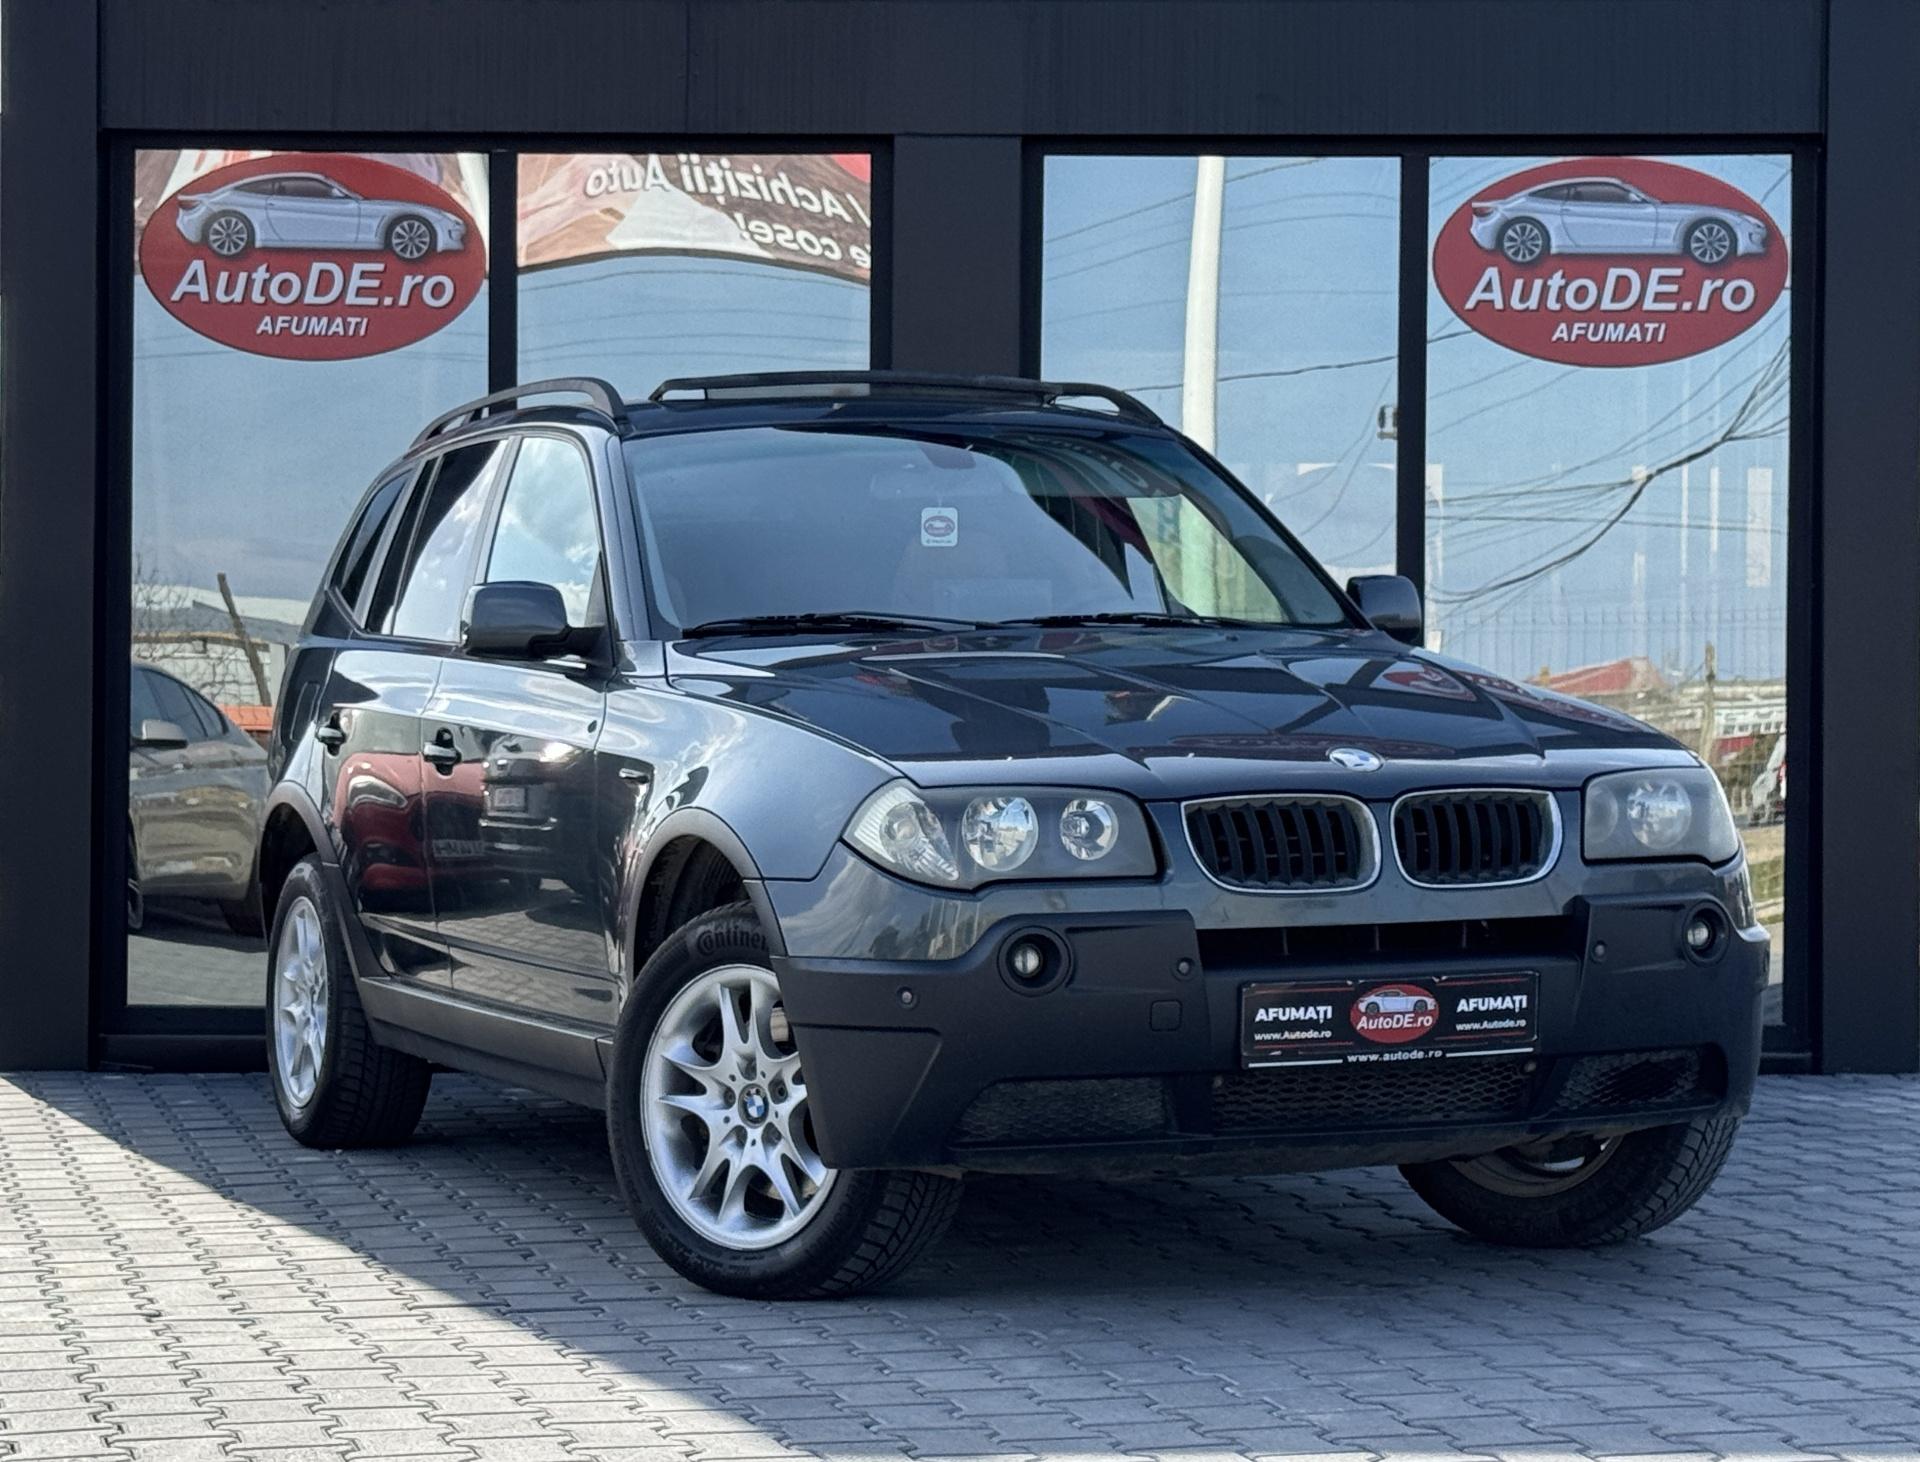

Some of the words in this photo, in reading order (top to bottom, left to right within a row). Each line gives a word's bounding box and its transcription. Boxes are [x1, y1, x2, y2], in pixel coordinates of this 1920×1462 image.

[171, 259, 455, 307] AutoDE.ro
[1465, 266, 1757, 313] AutoDE.ro
[256, 315, 369, 337] AFUMATI
[1551, 322, 1667, 344] AFUMATI
[1356, 1013, 1433, 1031] AutoDE.ro
[1456, 1018, 1527, 1031] www.Autode.ro
[1254, 1029, 1332, 1041] www.Autode.ro
[1347, 1049, 1443, 1063] www.autode.ro
